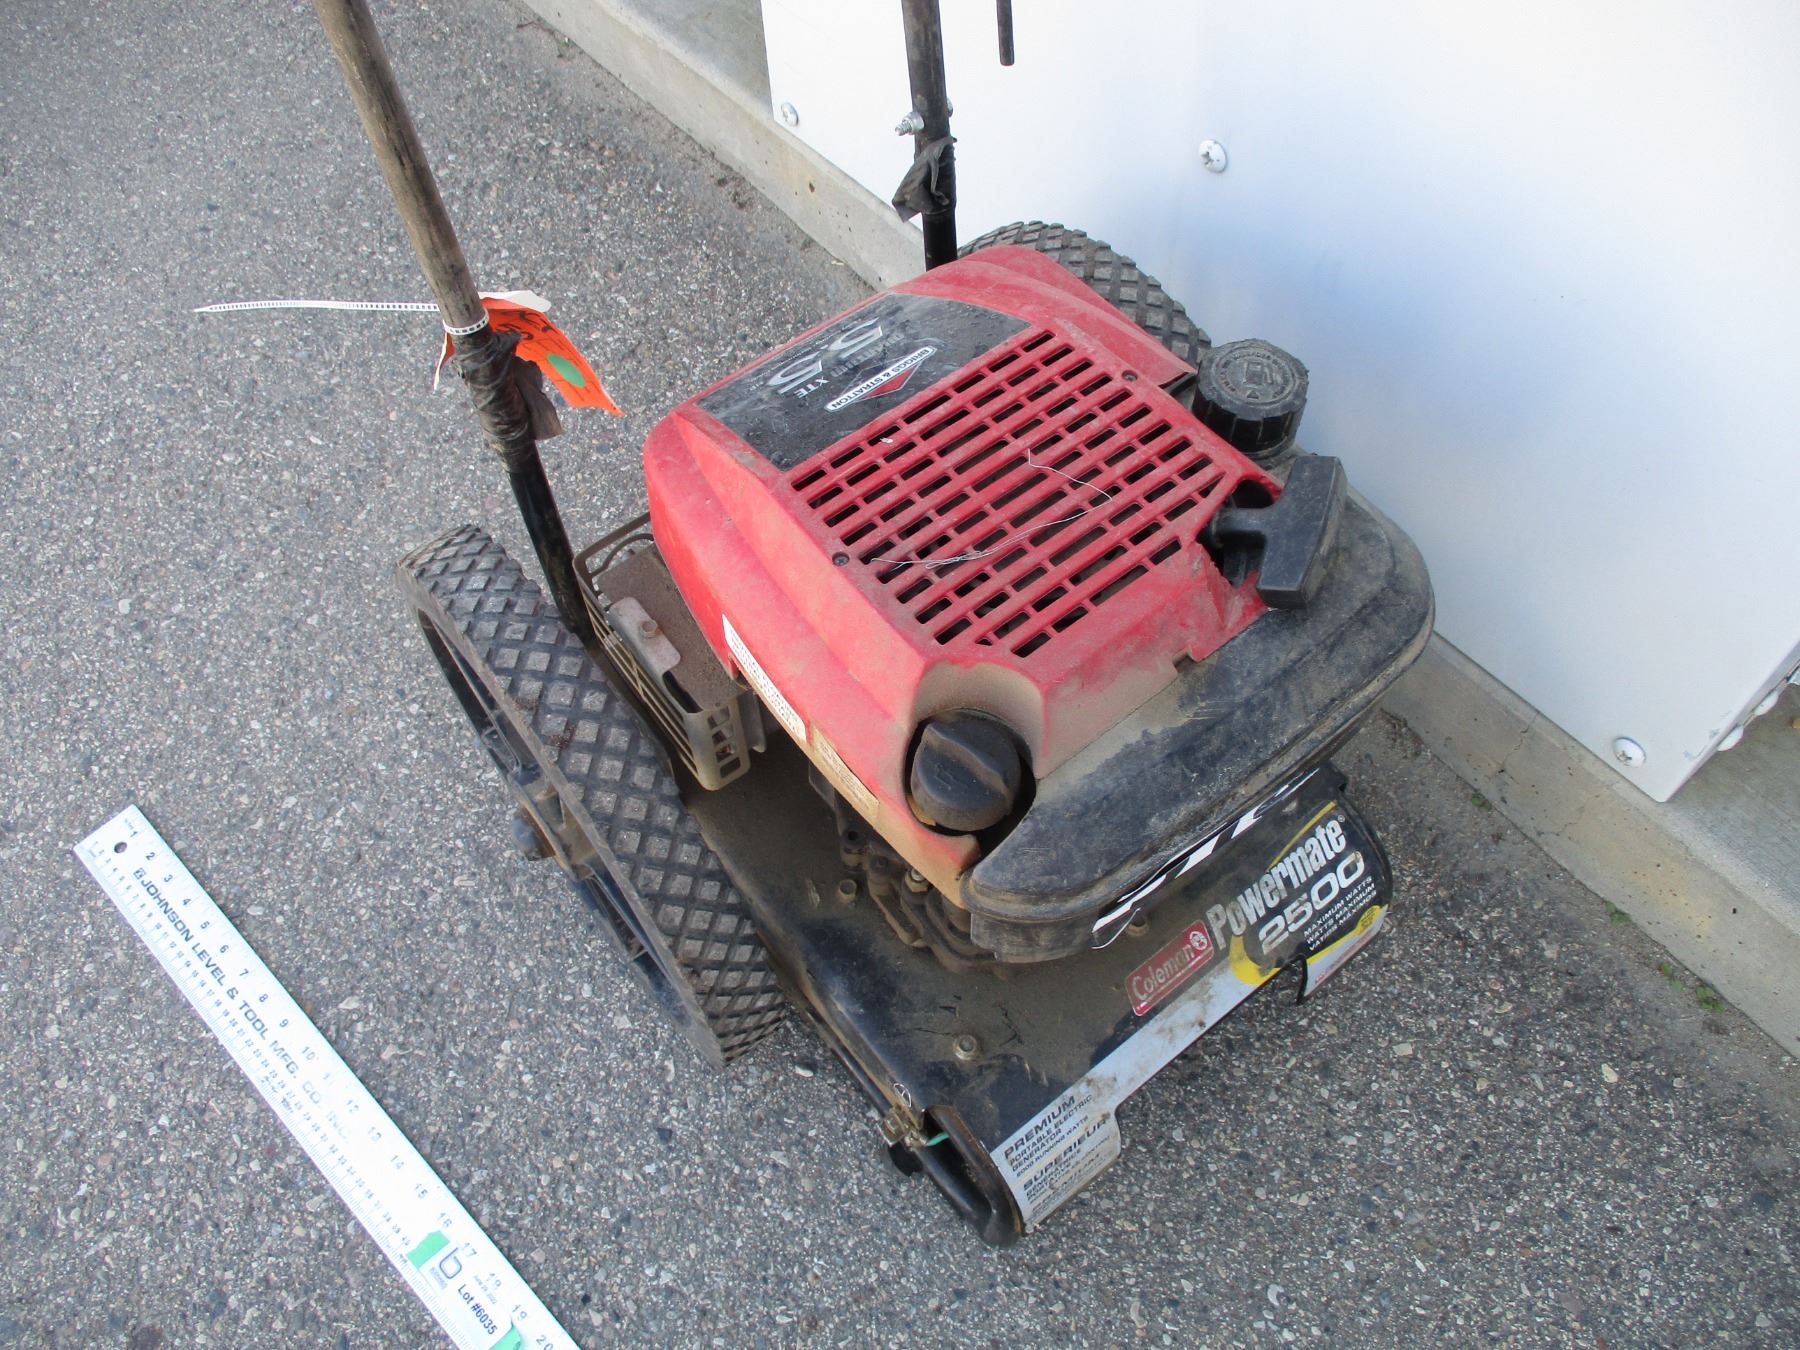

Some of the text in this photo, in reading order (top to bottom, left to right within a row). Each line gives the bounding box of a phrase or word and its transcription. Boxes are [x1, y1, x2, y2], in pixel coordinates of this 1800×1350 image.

[767, 316, 882, 395] 5.5
[892, 348, 929, 373] BRIGGS
[796, 376, 830, 398] XTE
[831, 376, 882, 408] STRATTON
[1206, 819, 1347, 950] Powermate
[1259, 851, 1365, 955] 2500
[1302, 898, 1344, 937] MAXIMUM
[1344, 875, 1372, 901] WATTS
[1305, 917, 1334, 944] WATTS
[1334, 882, 1374, 920] MAXIMUM
[140, 877, 193, 941] JOHNSON
[191, 942, 228, 985] LEVEL
[227, 987, 239, 999] &
[237, 1000, 271, 1039] TOOL
[269, 1040, 302, 1078] MFG.
[1132, 942, 1201, 1000] Coleman
[146, 852, 155, 860] 2
[164, 874, 172, 882] 3
[182, 897, 191, 906] 4
[219, 944, 228, 953] 6
[239, 969, 248, 977] 7
[259, 994, 267, 1002] 8
[279, 1019, 288, 1027] 9
[301, 1047, 314, 1060] 10
[412, 1182, 428, 1199] 15
[461, 1242, 476, 1258] 17
[1003, 1094, 1076, 1159] PREMIUM
[1008, 1126, 1052, 1166] PORTABLE
[1053, 1093, 1092, 1129] ELECTRIC
[1011, 1127, 1062, 1172] GENERATOR
[1034, 1134, 1065, 1162] RUNNING
[457, 1284, 498, 1334] Lot #6035
